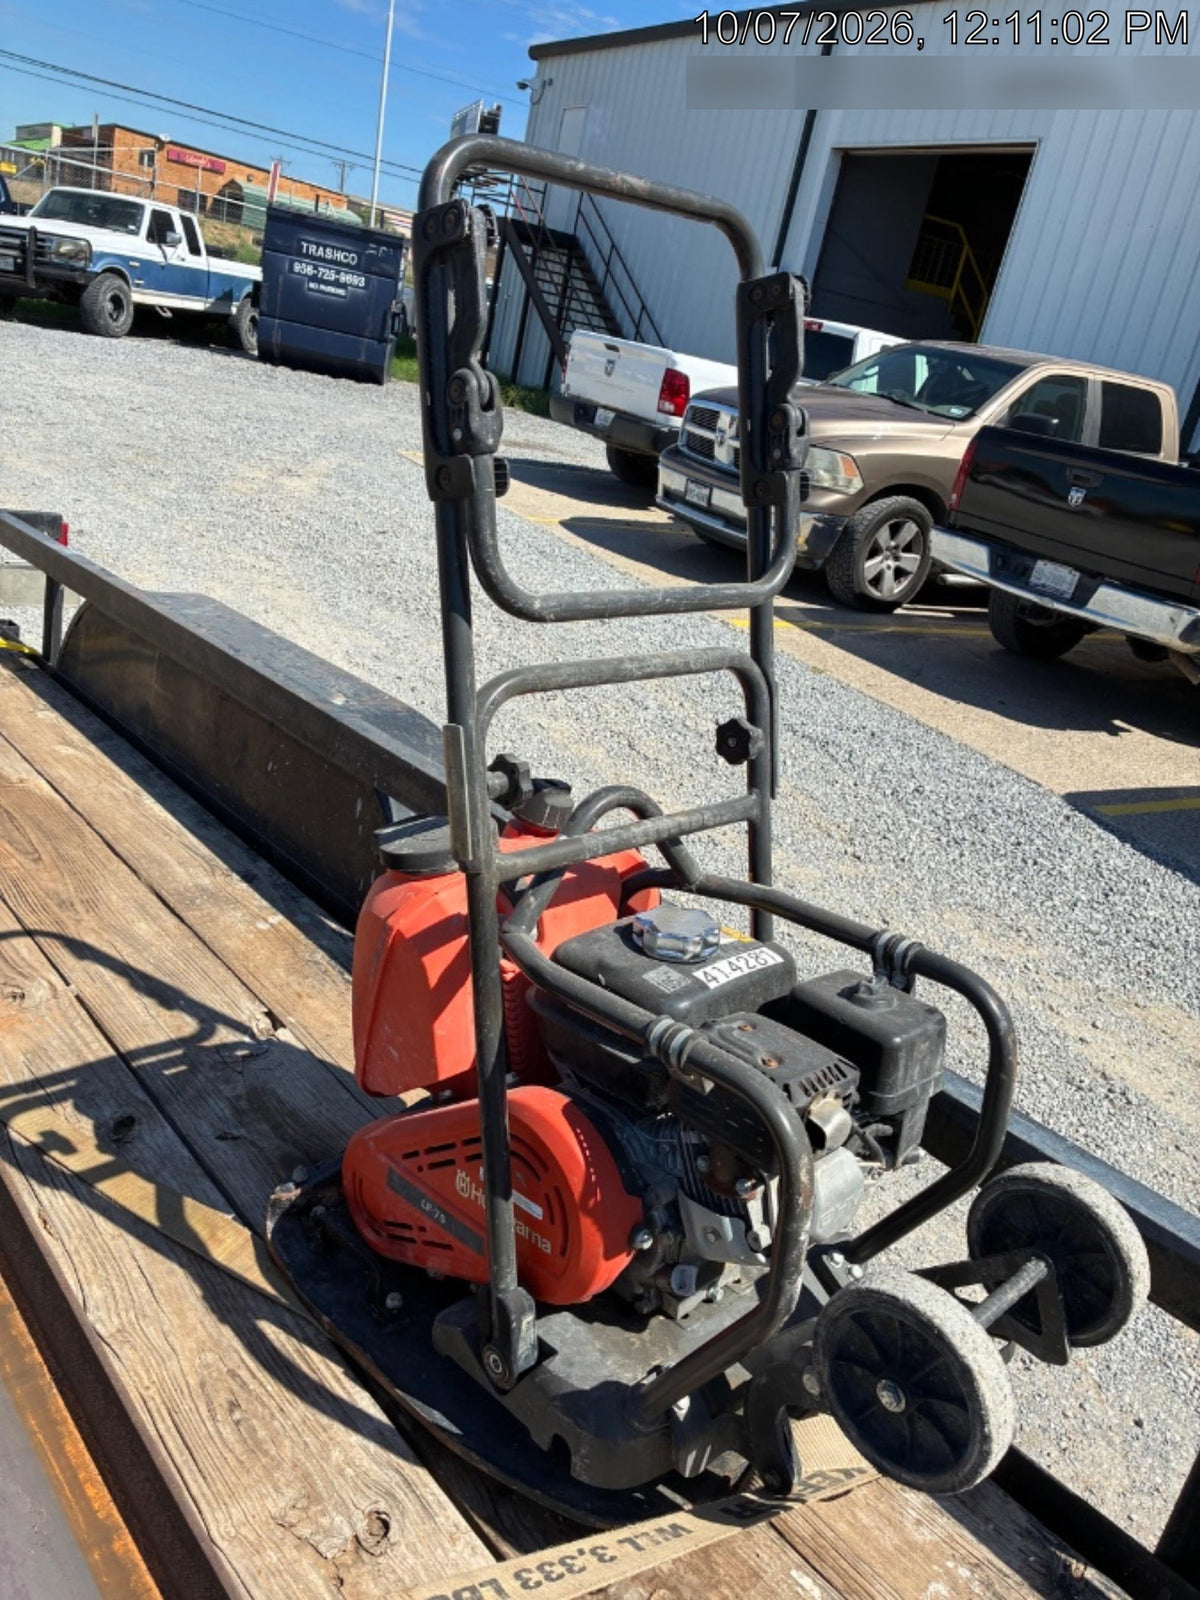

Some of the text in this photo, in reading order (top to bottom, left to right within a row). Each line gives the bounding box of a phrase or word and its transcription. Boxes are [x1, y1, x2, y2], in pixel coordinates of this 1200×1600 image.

[301, 241, 358, 265] TRASHCO
[617, 1522, 693, 1553] WLL
[513, 1545, 617, 1591] 3,333
